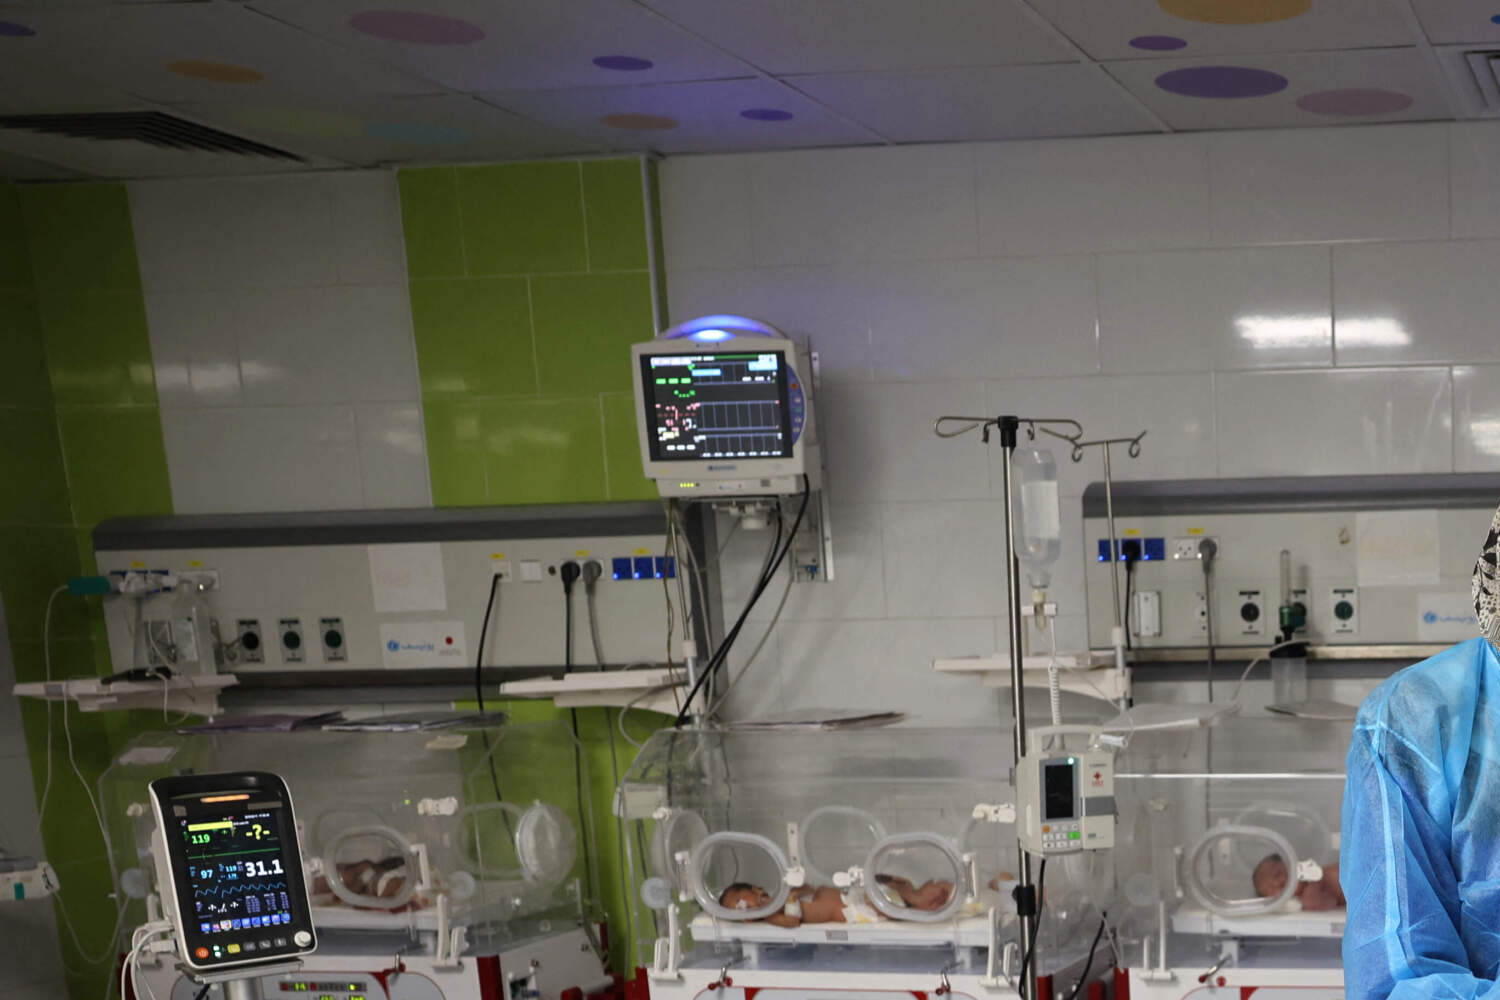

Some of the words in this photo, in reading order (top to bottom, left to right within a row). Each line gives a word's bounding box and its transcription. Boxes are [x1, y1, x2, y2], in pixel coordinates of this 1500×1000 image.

[191, 834, 211, 845] 119
[200, 869, 213, 879] 97
[244, 859, 284, 877] 31.1
